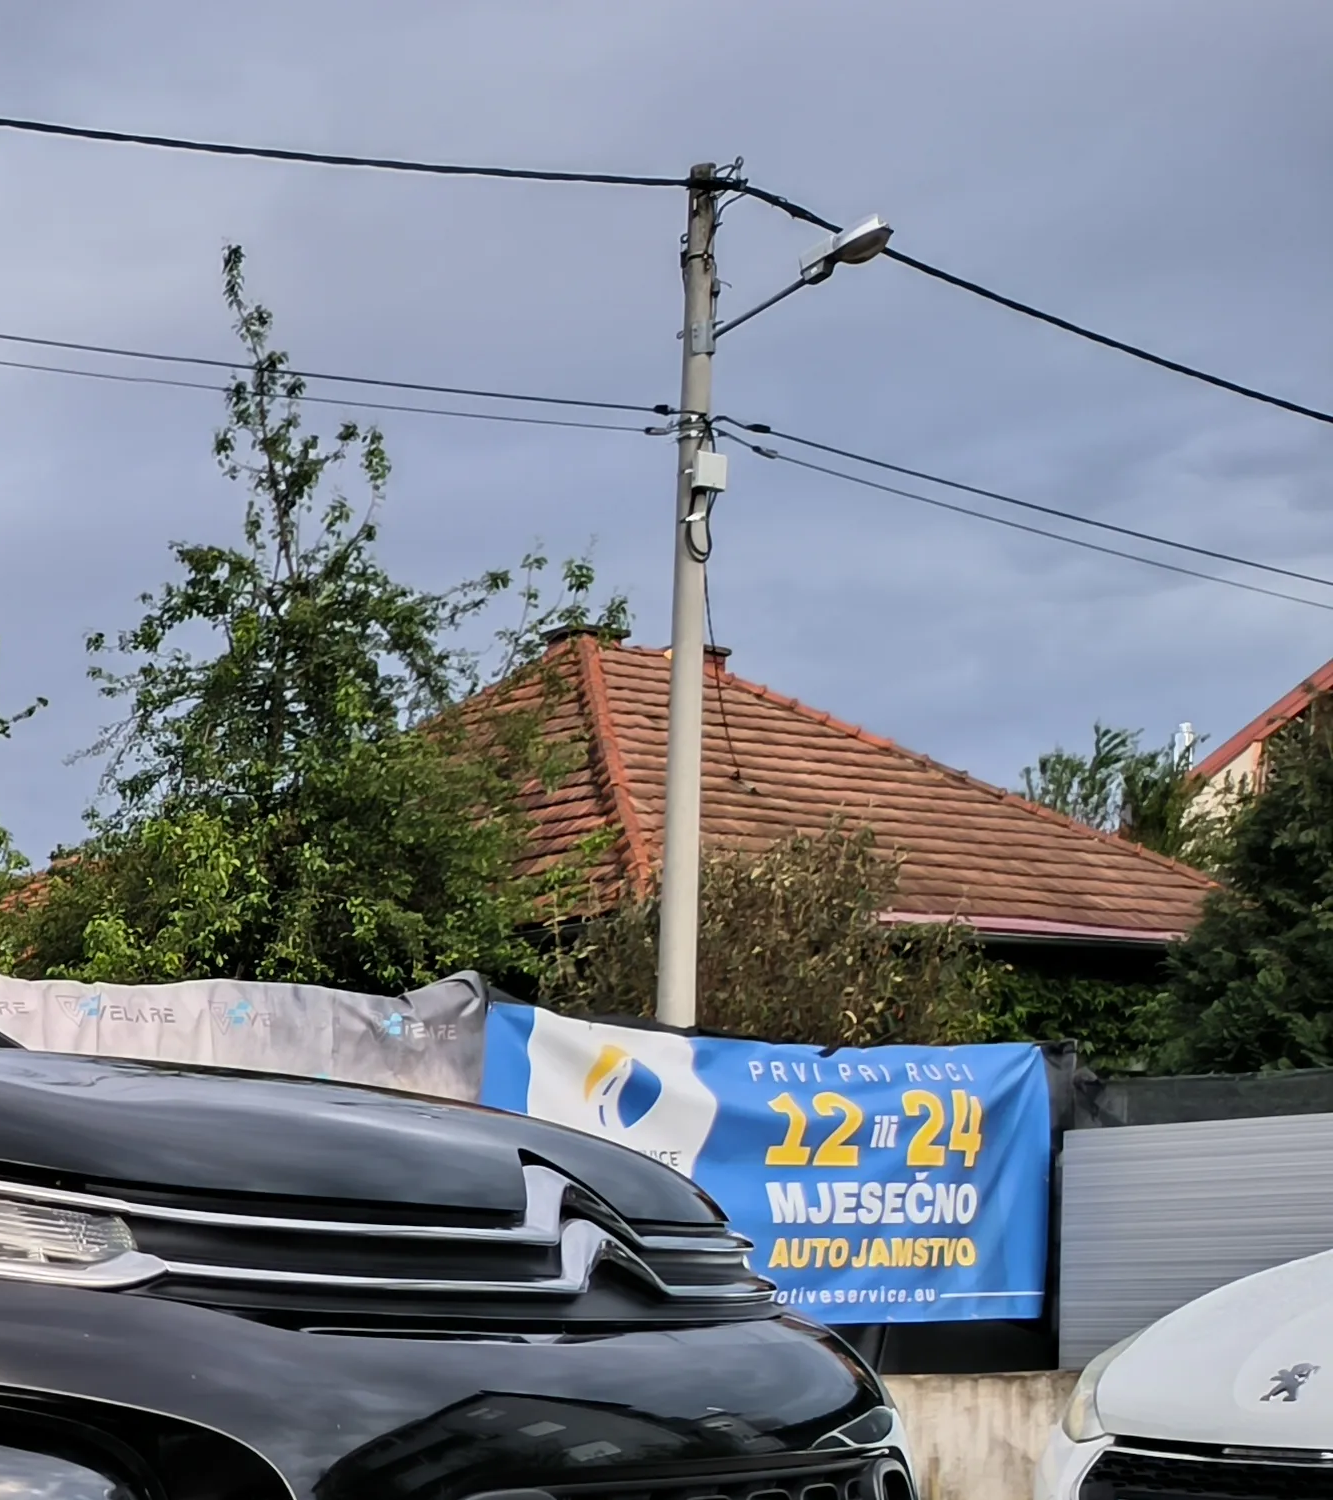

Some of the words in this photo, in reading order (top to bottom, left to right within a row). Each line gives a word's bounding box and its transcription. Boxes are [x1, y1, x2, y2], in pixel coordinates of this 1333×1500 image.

[748, 1061, 823, 1083] PRVI
[838, 1063, 891, 1083] PRI
[905, 1062, 975, 1082] RUCI
[764, 1091, 864, 1167] 12
[870, 1115, 899, 1148] ili
[901, 1089, 983, 1168] 24
[764, 1172, 978, 1225] MJESEČNO
[767, 1237, 850, 1268] AUTO
[851, 1237, 977, 1268] JAMSTVO
